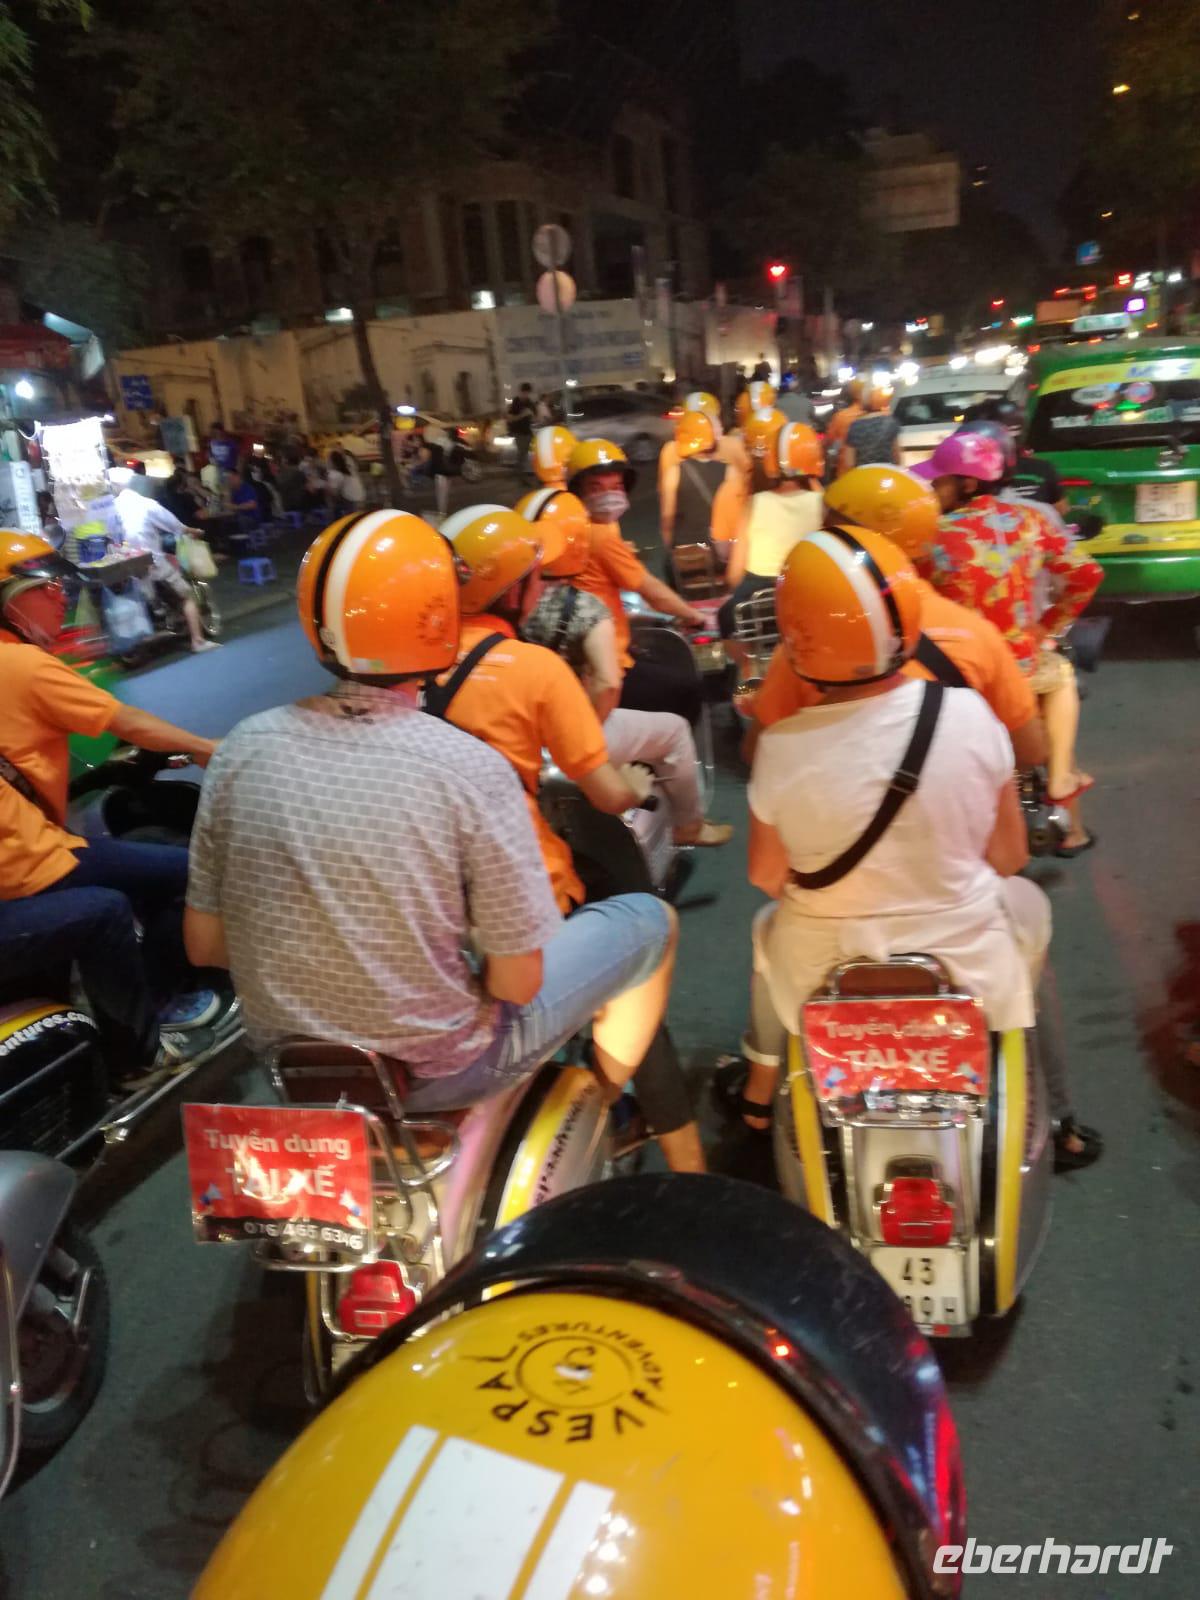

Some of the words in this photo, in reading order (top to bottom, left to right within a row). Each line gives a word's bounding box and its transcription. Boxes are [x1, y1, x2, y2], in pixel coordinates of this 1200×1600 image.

[284, 1133, 352, 1161] dụng
[902, 1257, 933, 1286] 43
[475, 1370, 647, 1445] VESPA
